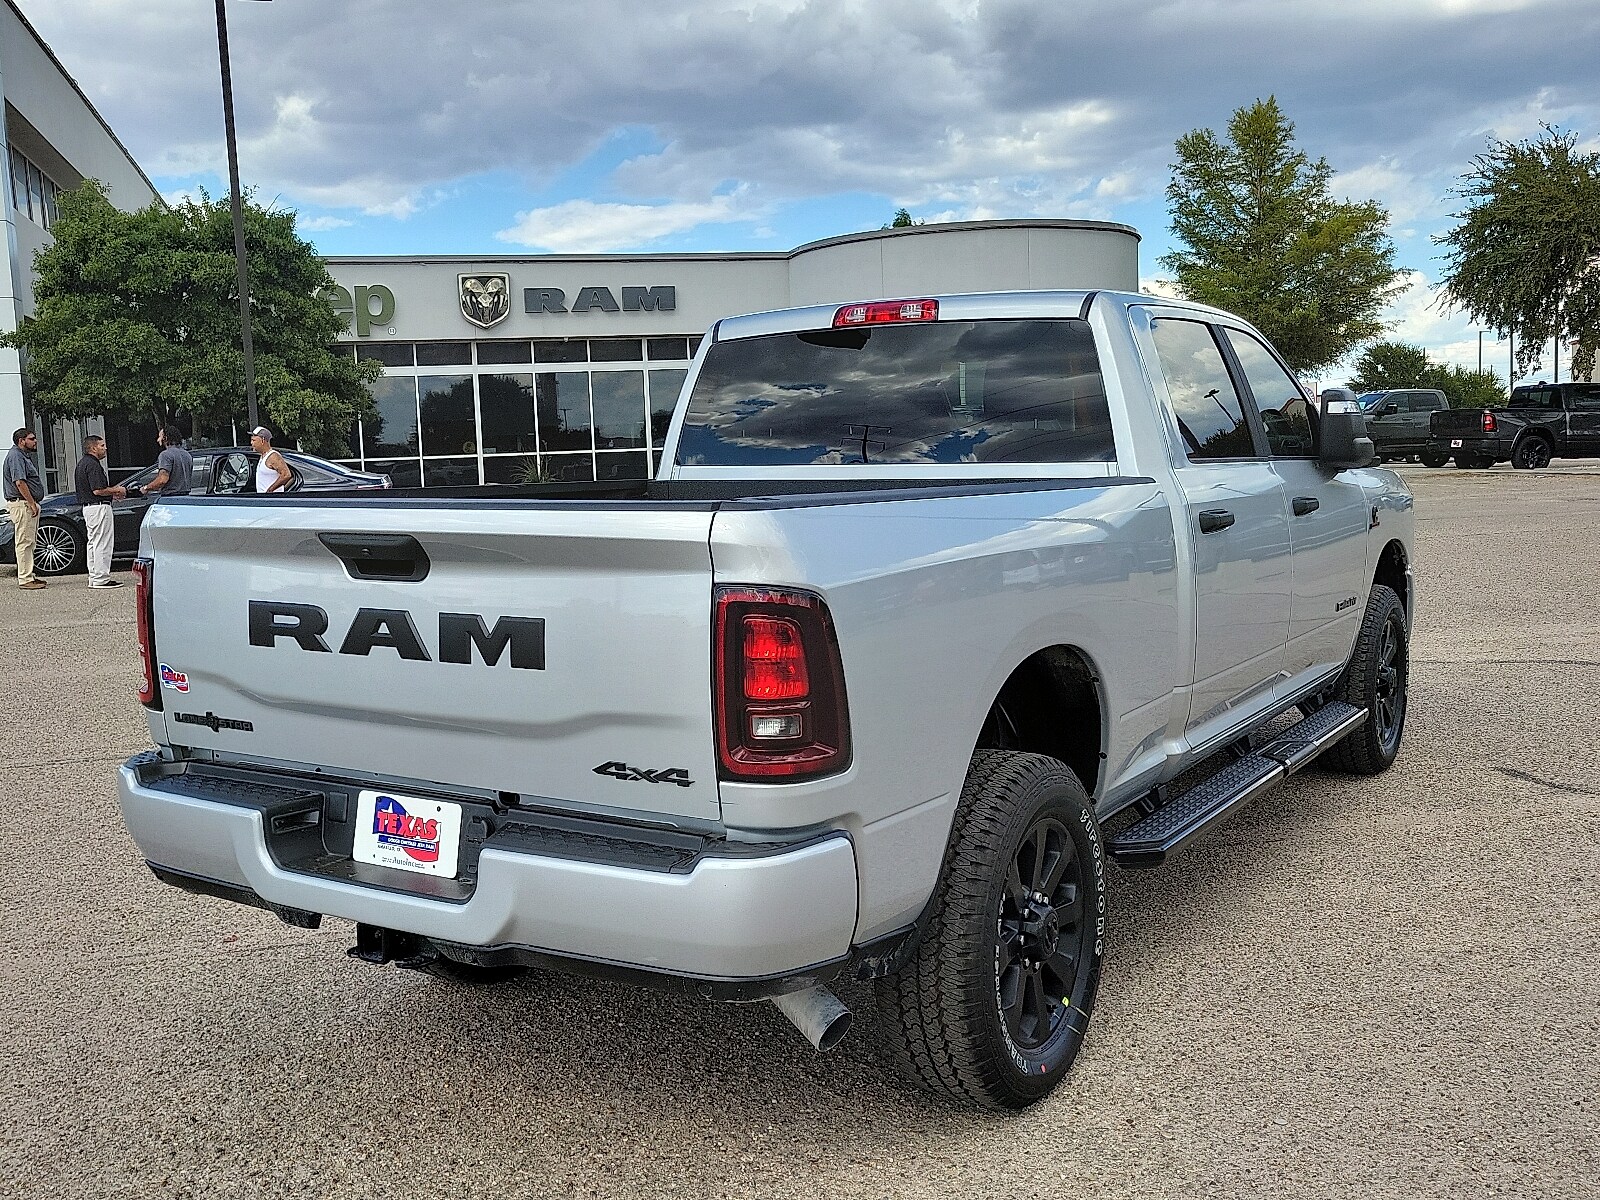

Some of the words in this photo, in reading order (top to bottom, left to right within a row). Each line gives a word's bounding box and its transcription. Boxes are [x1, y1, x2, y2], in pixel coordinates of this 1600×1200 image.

[317, 284, 396, 336] ep
[523, 286, 676, 314] RAM
[248, 600, 546, 671] RAM
[218, 718, 254, 732] STAR
[377, 811, 438, 840] TEXAS
[1080, 808, 1105, 957] Firestone
